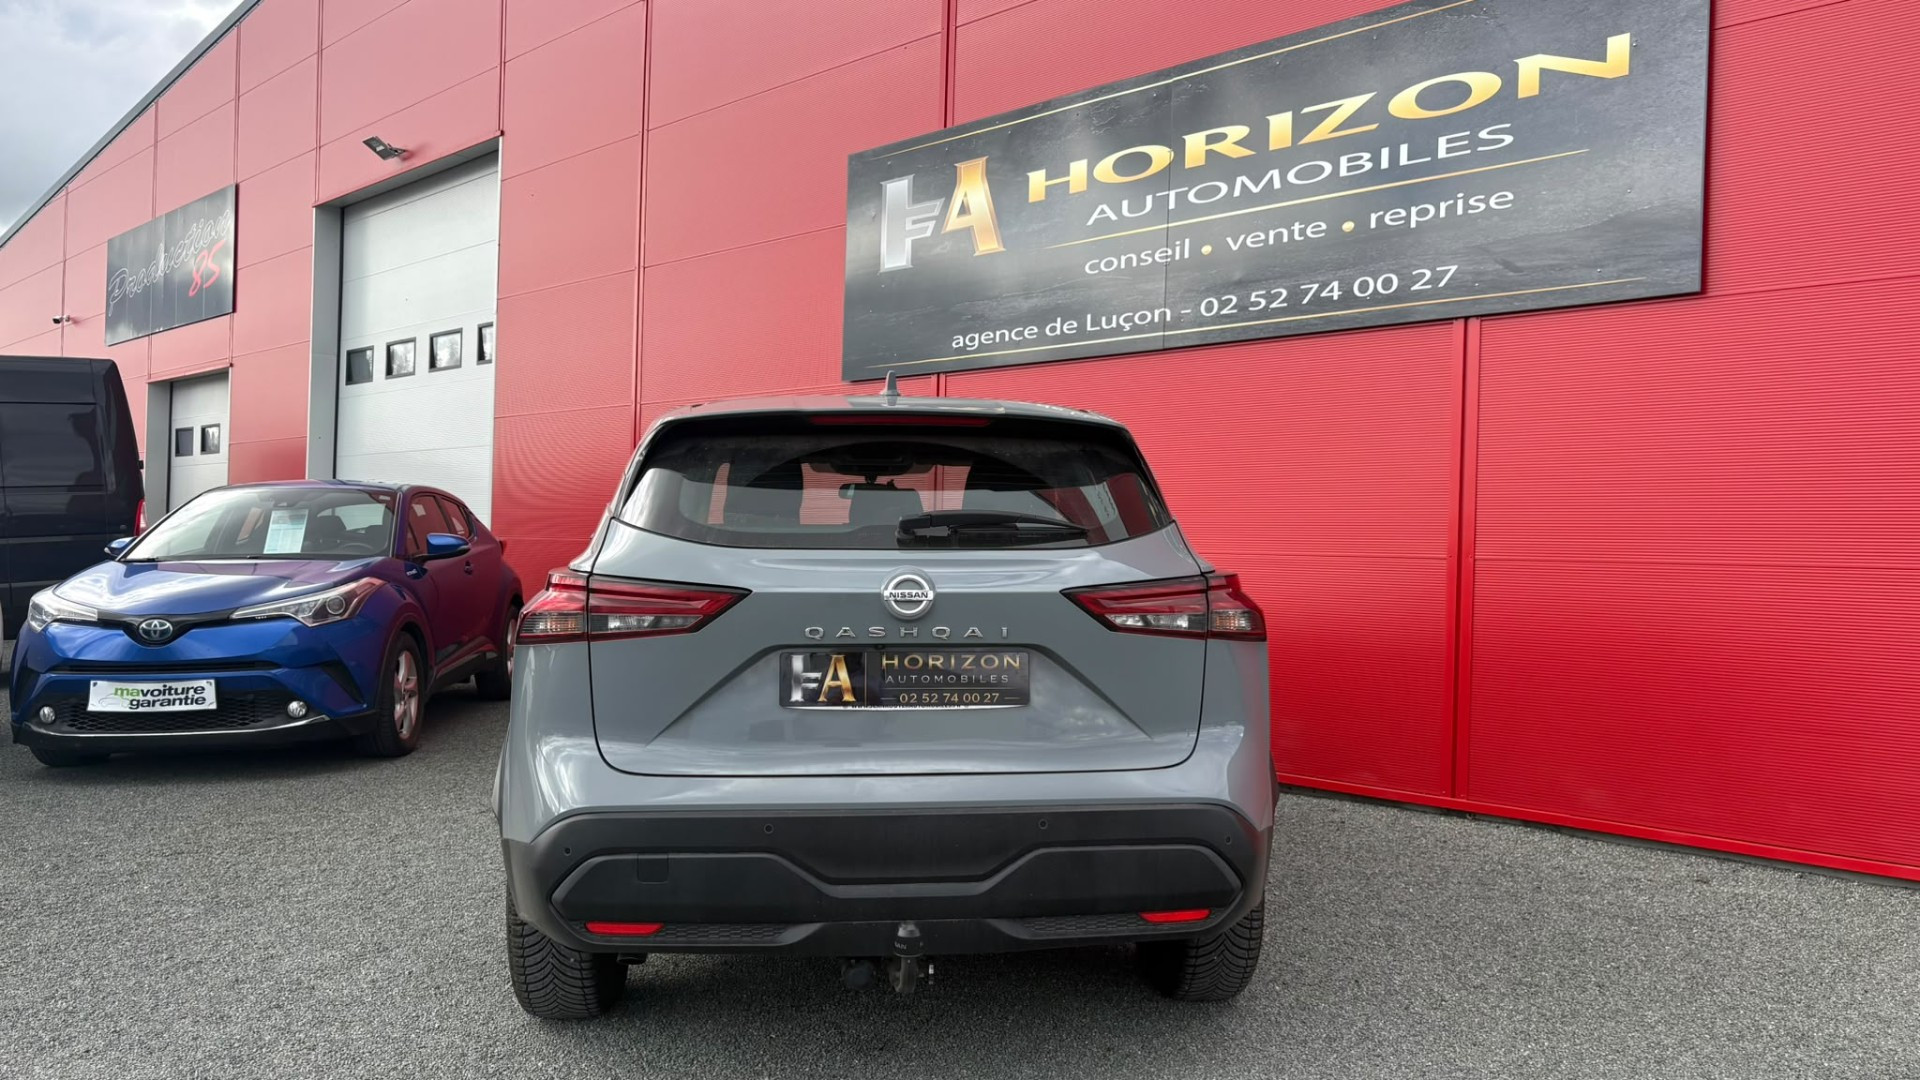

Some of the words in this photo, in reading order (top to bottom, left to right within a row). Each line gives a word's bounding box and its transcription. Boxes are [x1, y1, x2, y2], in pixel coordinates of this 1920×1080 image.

[1026, 32, 1631, 203] HORIZON
[1086, 123, 1514, 226] AUTOMOBILES
[1084, 238, 1191, 275] conseil
[1225, 218, 1328, 251] vente
[1369, 190, 1514, 229] reprise
[108, 209, 231, 317] Production
[189, 240, 225, 297] 85
[951, 325, 1038, 351] agence
[1045, 316, 1078, 338] de
[1086, 306, 1171, 332] Luçon
[1200, 293, 1239, 318] 02
[1247, 287, 1289, 312] 52
[1299, 280, 1342, 305] 74
[1353, 272, 1399, 299] 00
[1409, 264, 1459, 292] 27
[804, 626, 1009, 640] QASHQAI
[882, 655, 1020, 669] HORIZON
[885, 674, 1009, 684] AUTOMOBILES
[113, 684, 206, 697] mavoiture
[128, 695, 206, 710] garantie
[899, 693, 917, 703] 02
[922, 693, 938, 703] 52
[943, 693, 958, 703] 74
[963, 693, 980, 703] 00
[983, 693, 999, 703] 27
